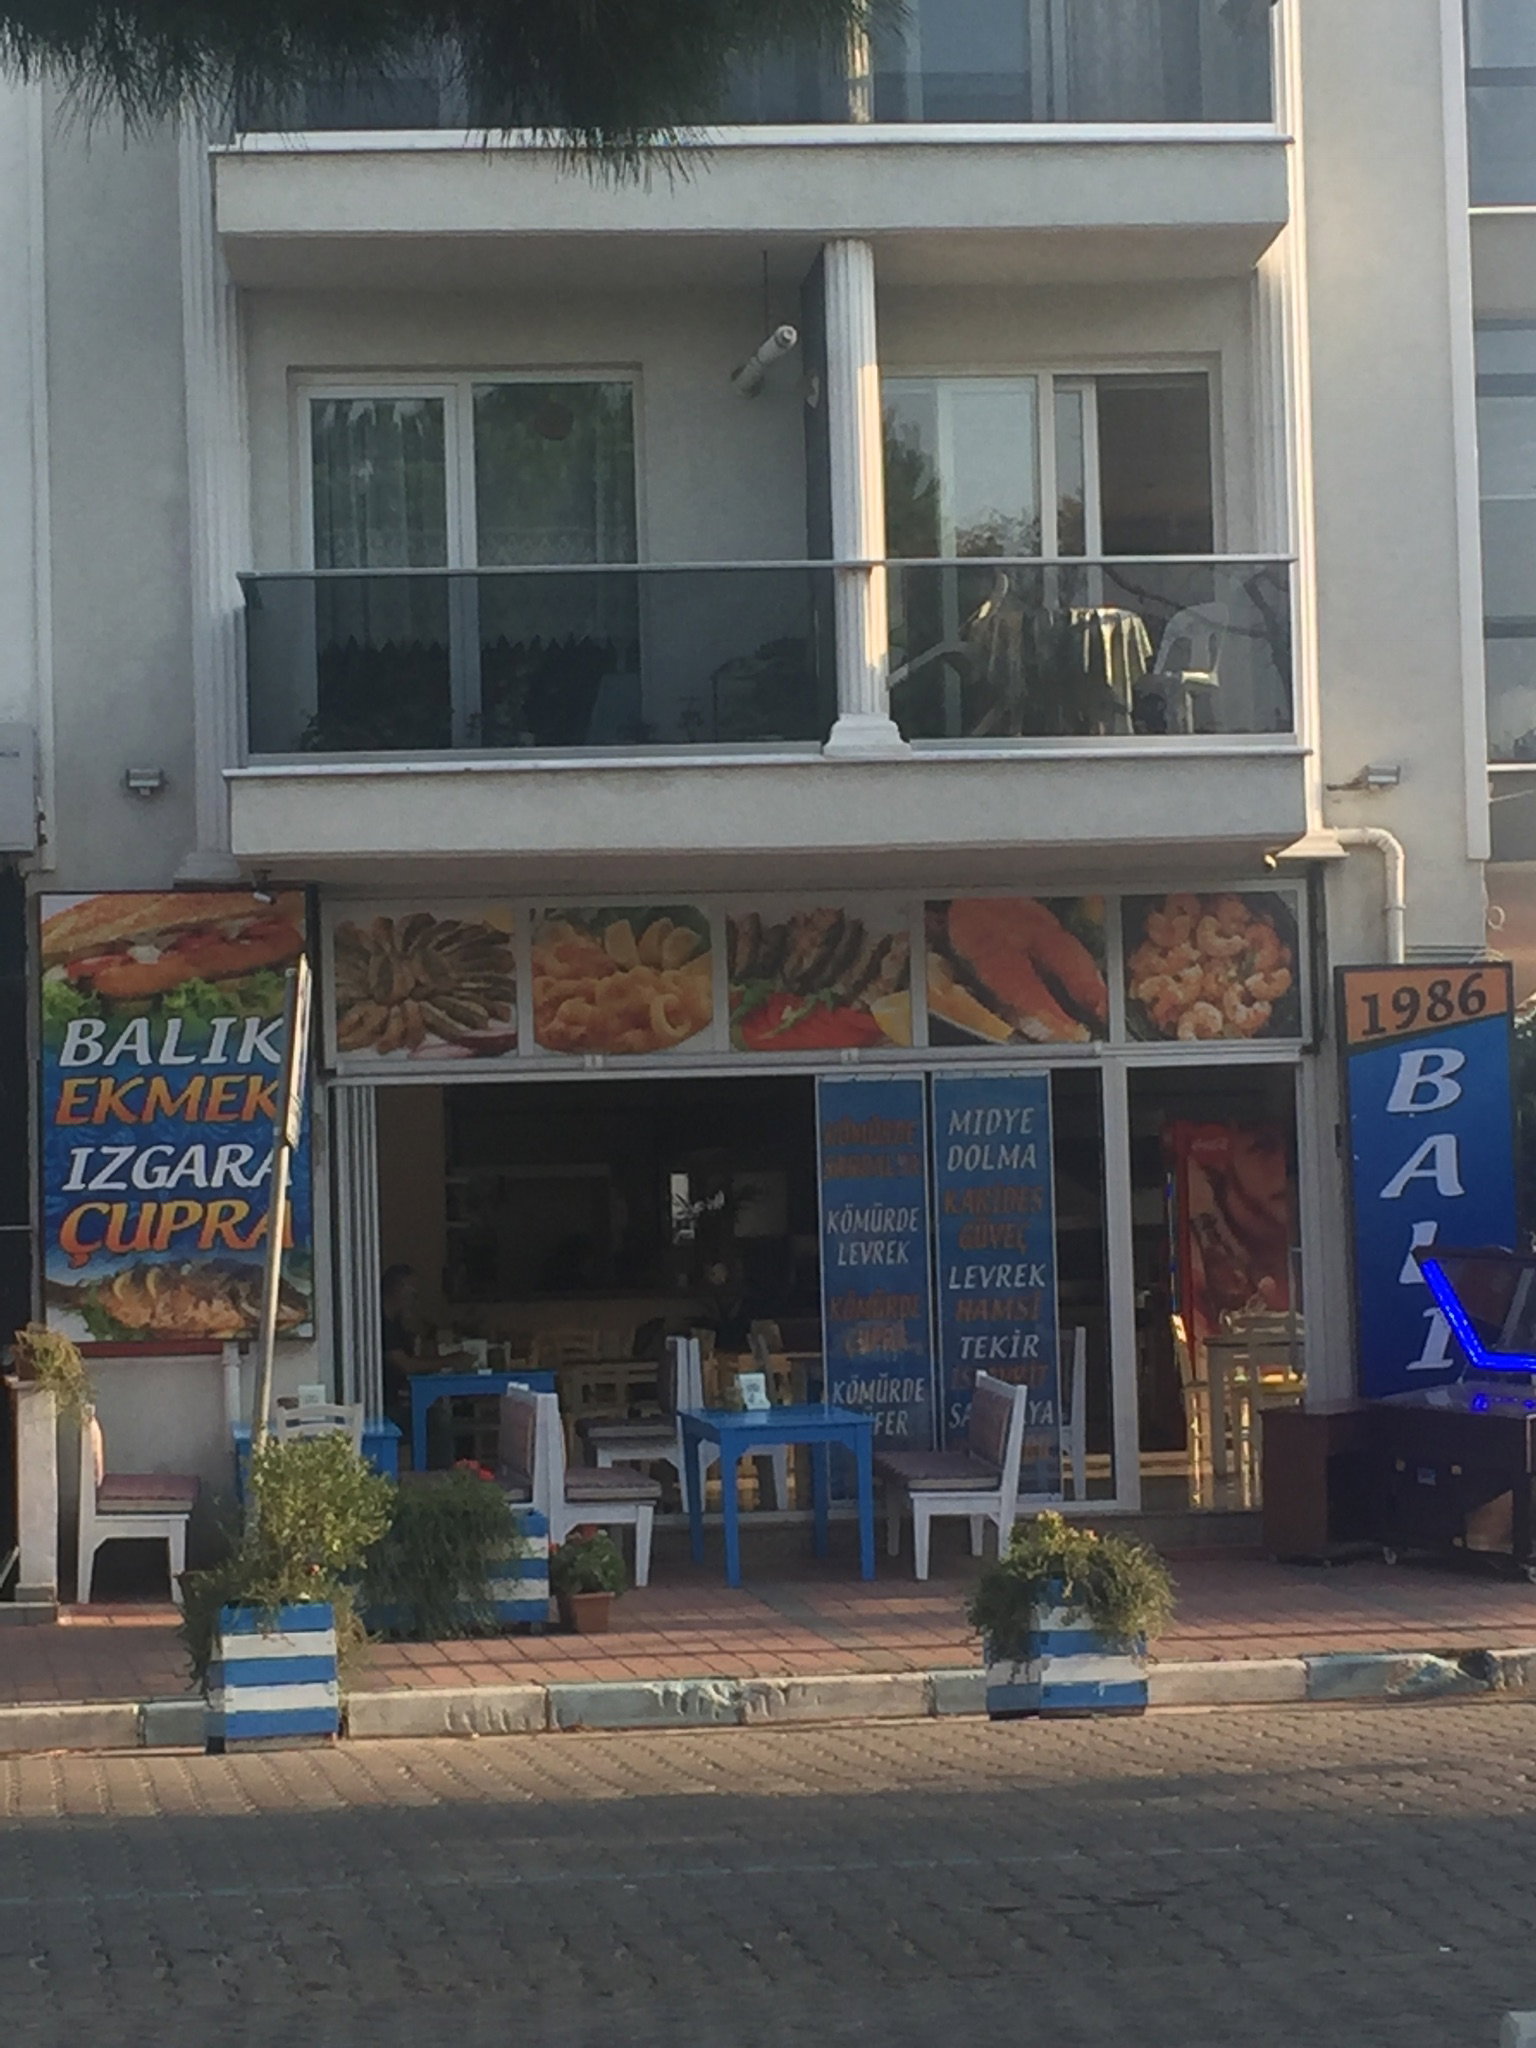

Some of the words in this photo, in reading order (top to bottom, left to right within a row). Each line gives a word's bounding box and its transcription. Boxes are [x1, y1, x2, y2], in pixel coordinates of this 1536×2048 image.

[1360, 973, 1487, 1036] 1986
[59, 1016, 284, 1068] BALIK
[55, 1074, 280, 1126] EKMEK
[947, 1143, 1036, 1172] DOLMA
[59, 1200, 294, 1268] ÇUPRA
[826, 1202, 919, 1235] KÖMÜRDE
[837, 1240, 910, 1266] LEVREK
[948, 1263, 1046, 1289] LEVREK
[960, 1329, 1040, 1359] TEKİR
